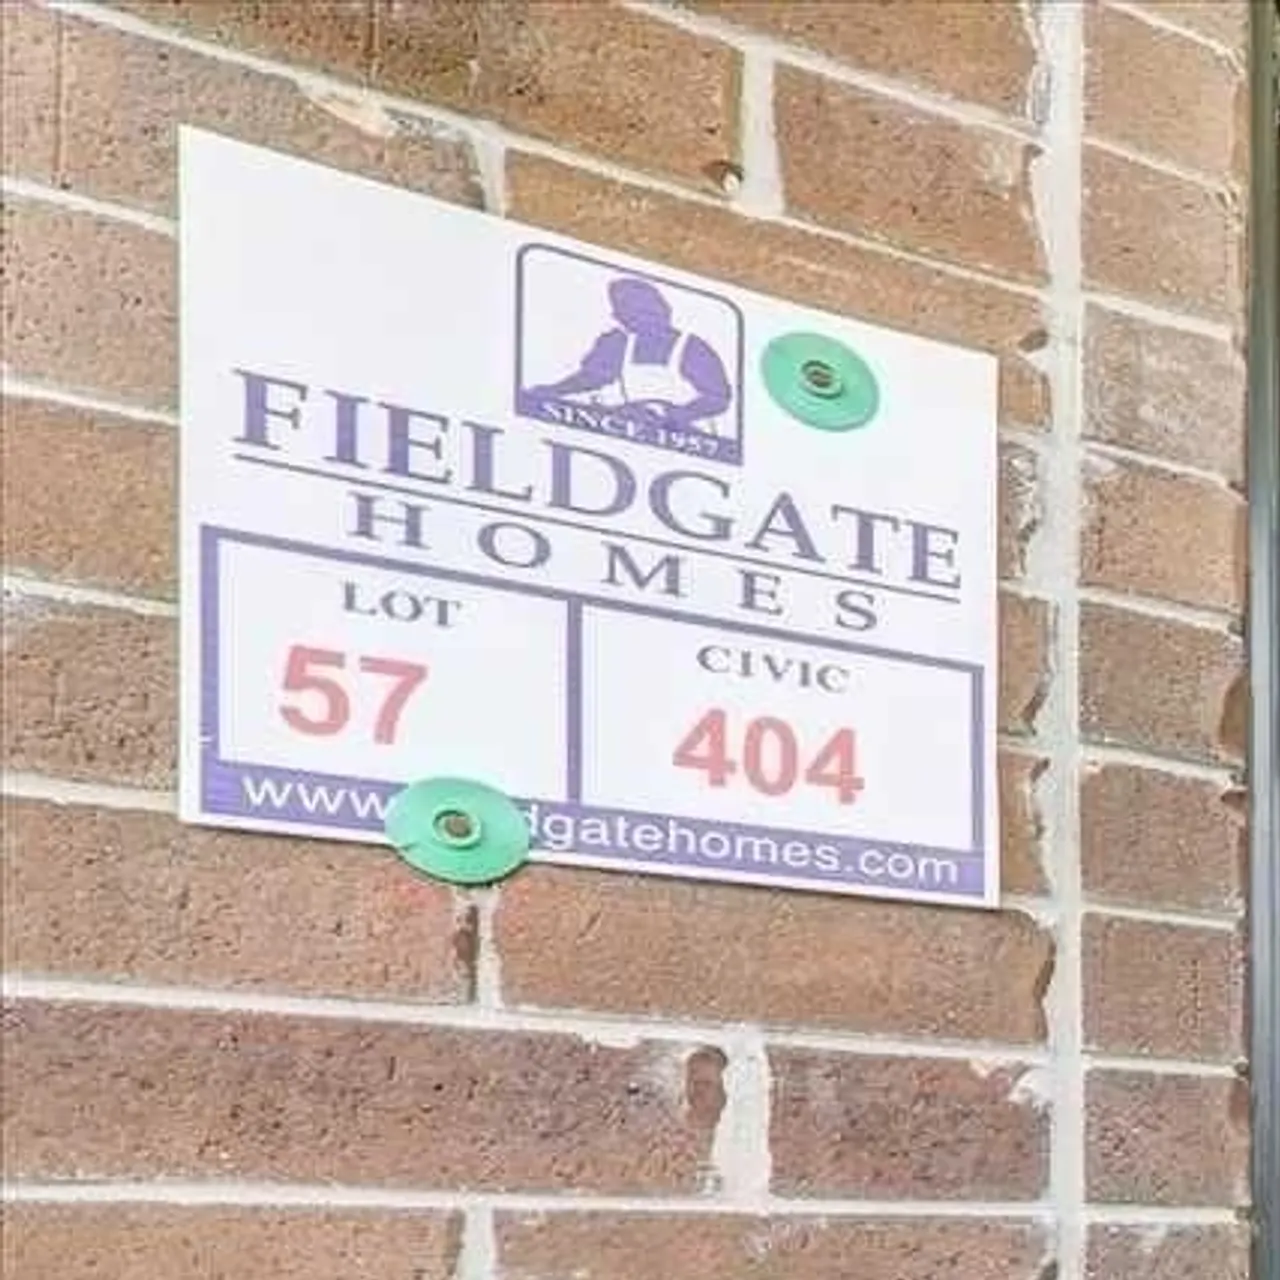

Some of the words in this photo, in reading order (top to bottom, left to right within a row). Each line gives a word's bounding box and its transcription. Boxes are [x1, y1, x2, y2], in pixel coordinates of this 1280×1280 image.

[232, 368, 962, 590] FIELDGATE
[341, 578, 462, 629] LOT
[346, 490, 879, 632] HOMES
[279, 644, 429, 746] 57
[696, 644, 852, 693] CIVIC
[671, 707, 867, 806] 404
[241, 775, 959, 884] wwwdgatehomes.com
